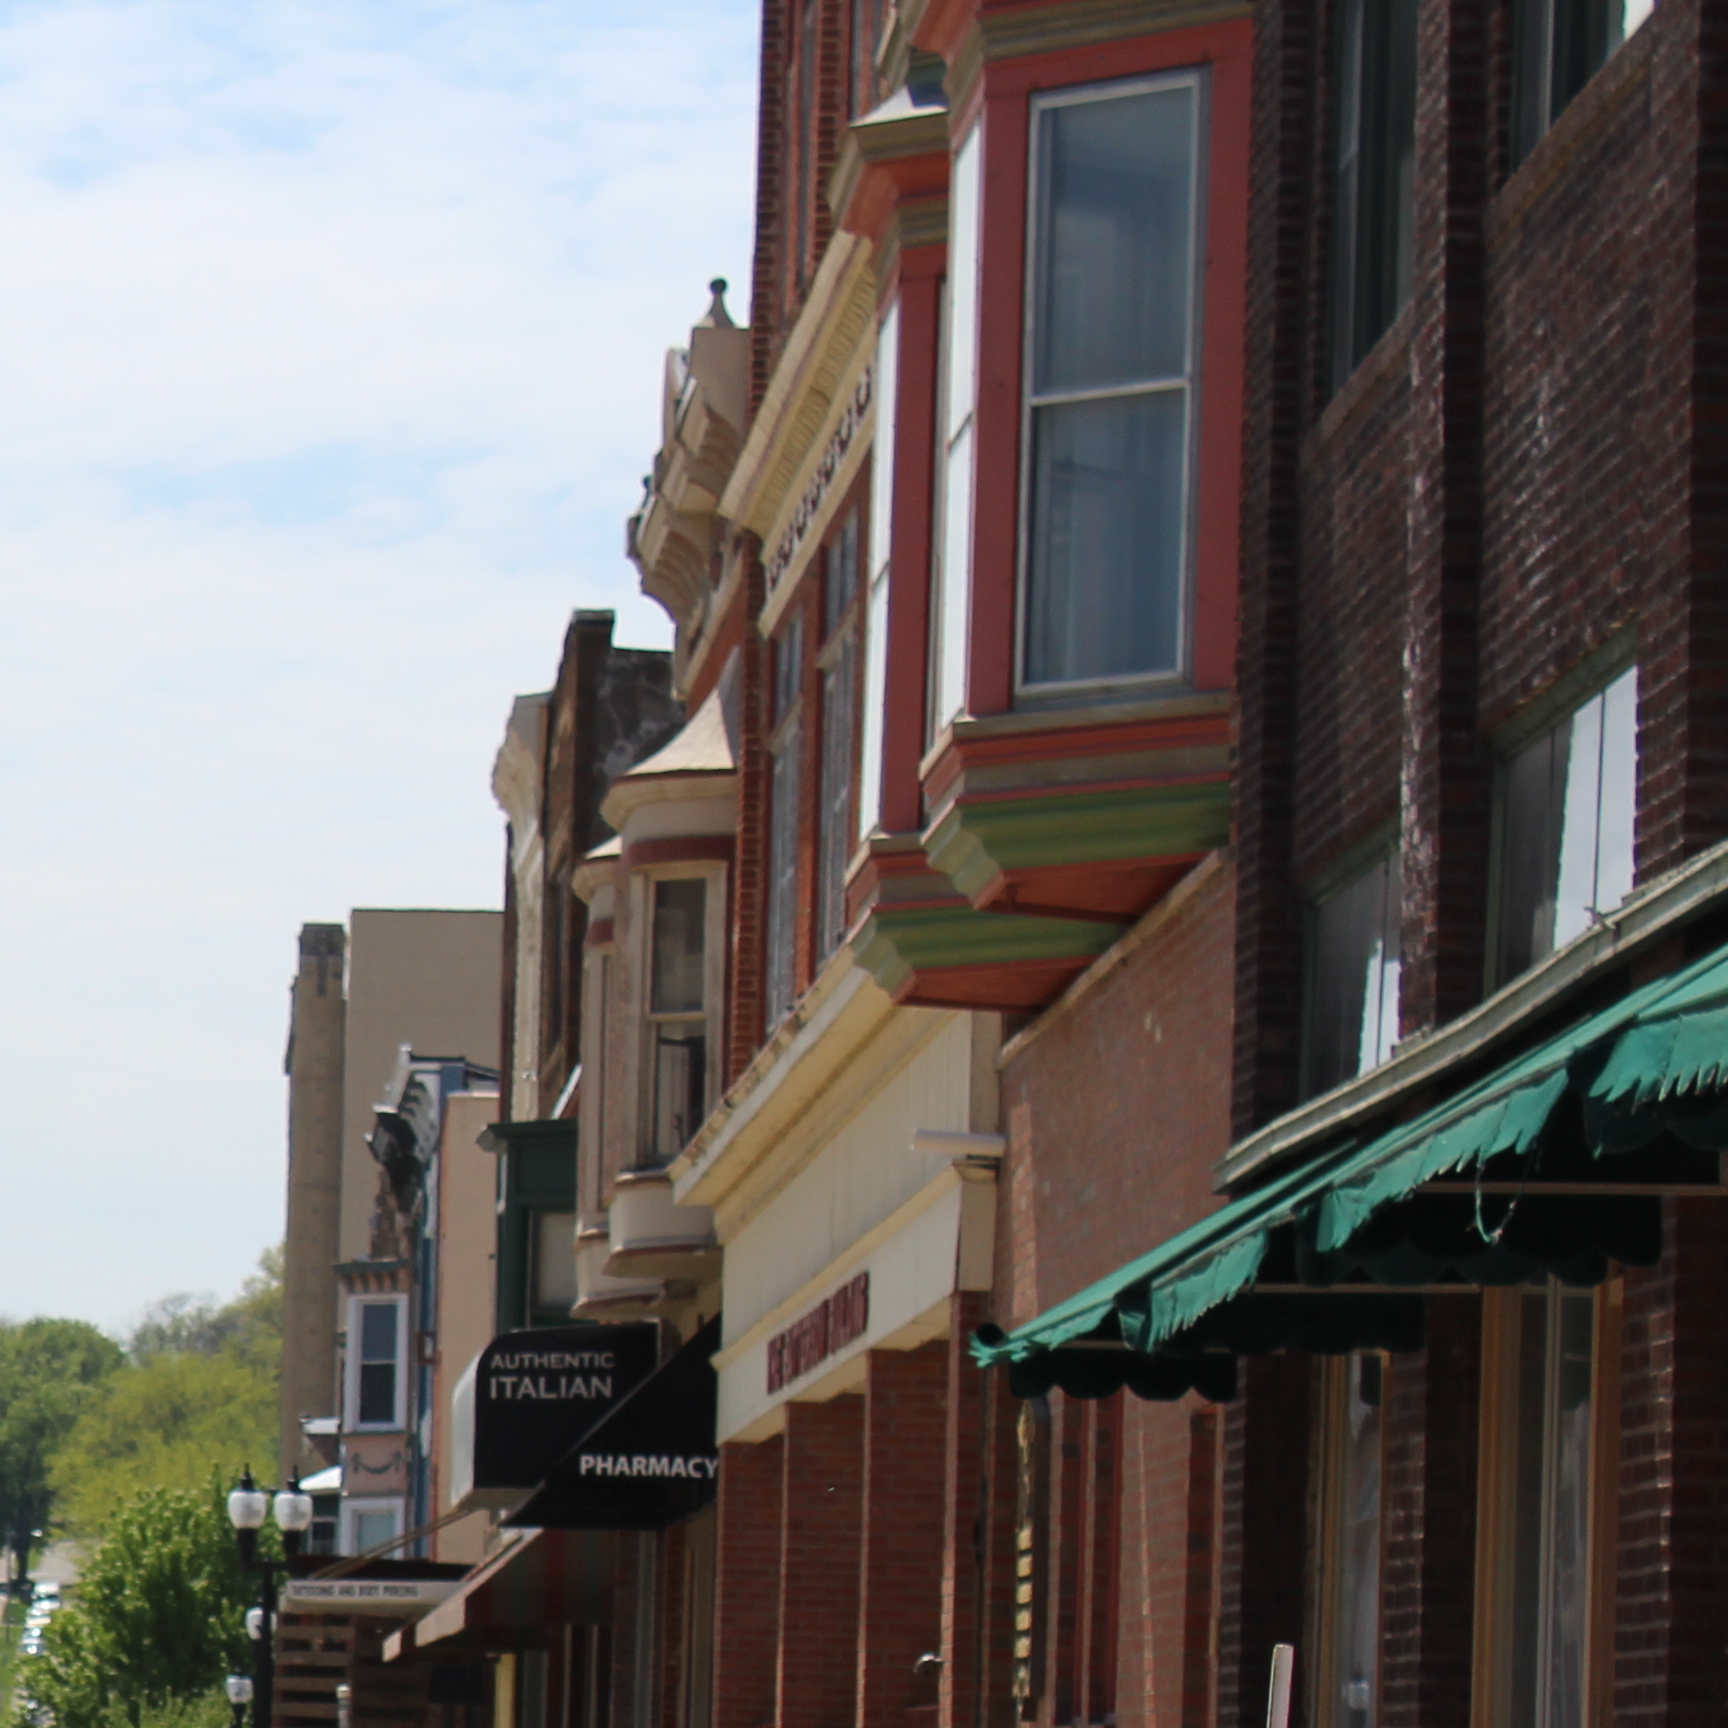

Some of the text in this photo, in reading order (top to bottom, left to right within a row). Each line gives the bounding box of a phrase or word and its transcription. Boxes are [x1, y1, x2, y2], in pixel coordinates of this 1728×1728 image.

[491, 1353, 615, 1370] AUTHENTIC
[490, 1376, 612, 1399] ITALIAN
[579, 1454, 718, 1478] PHARMACY
